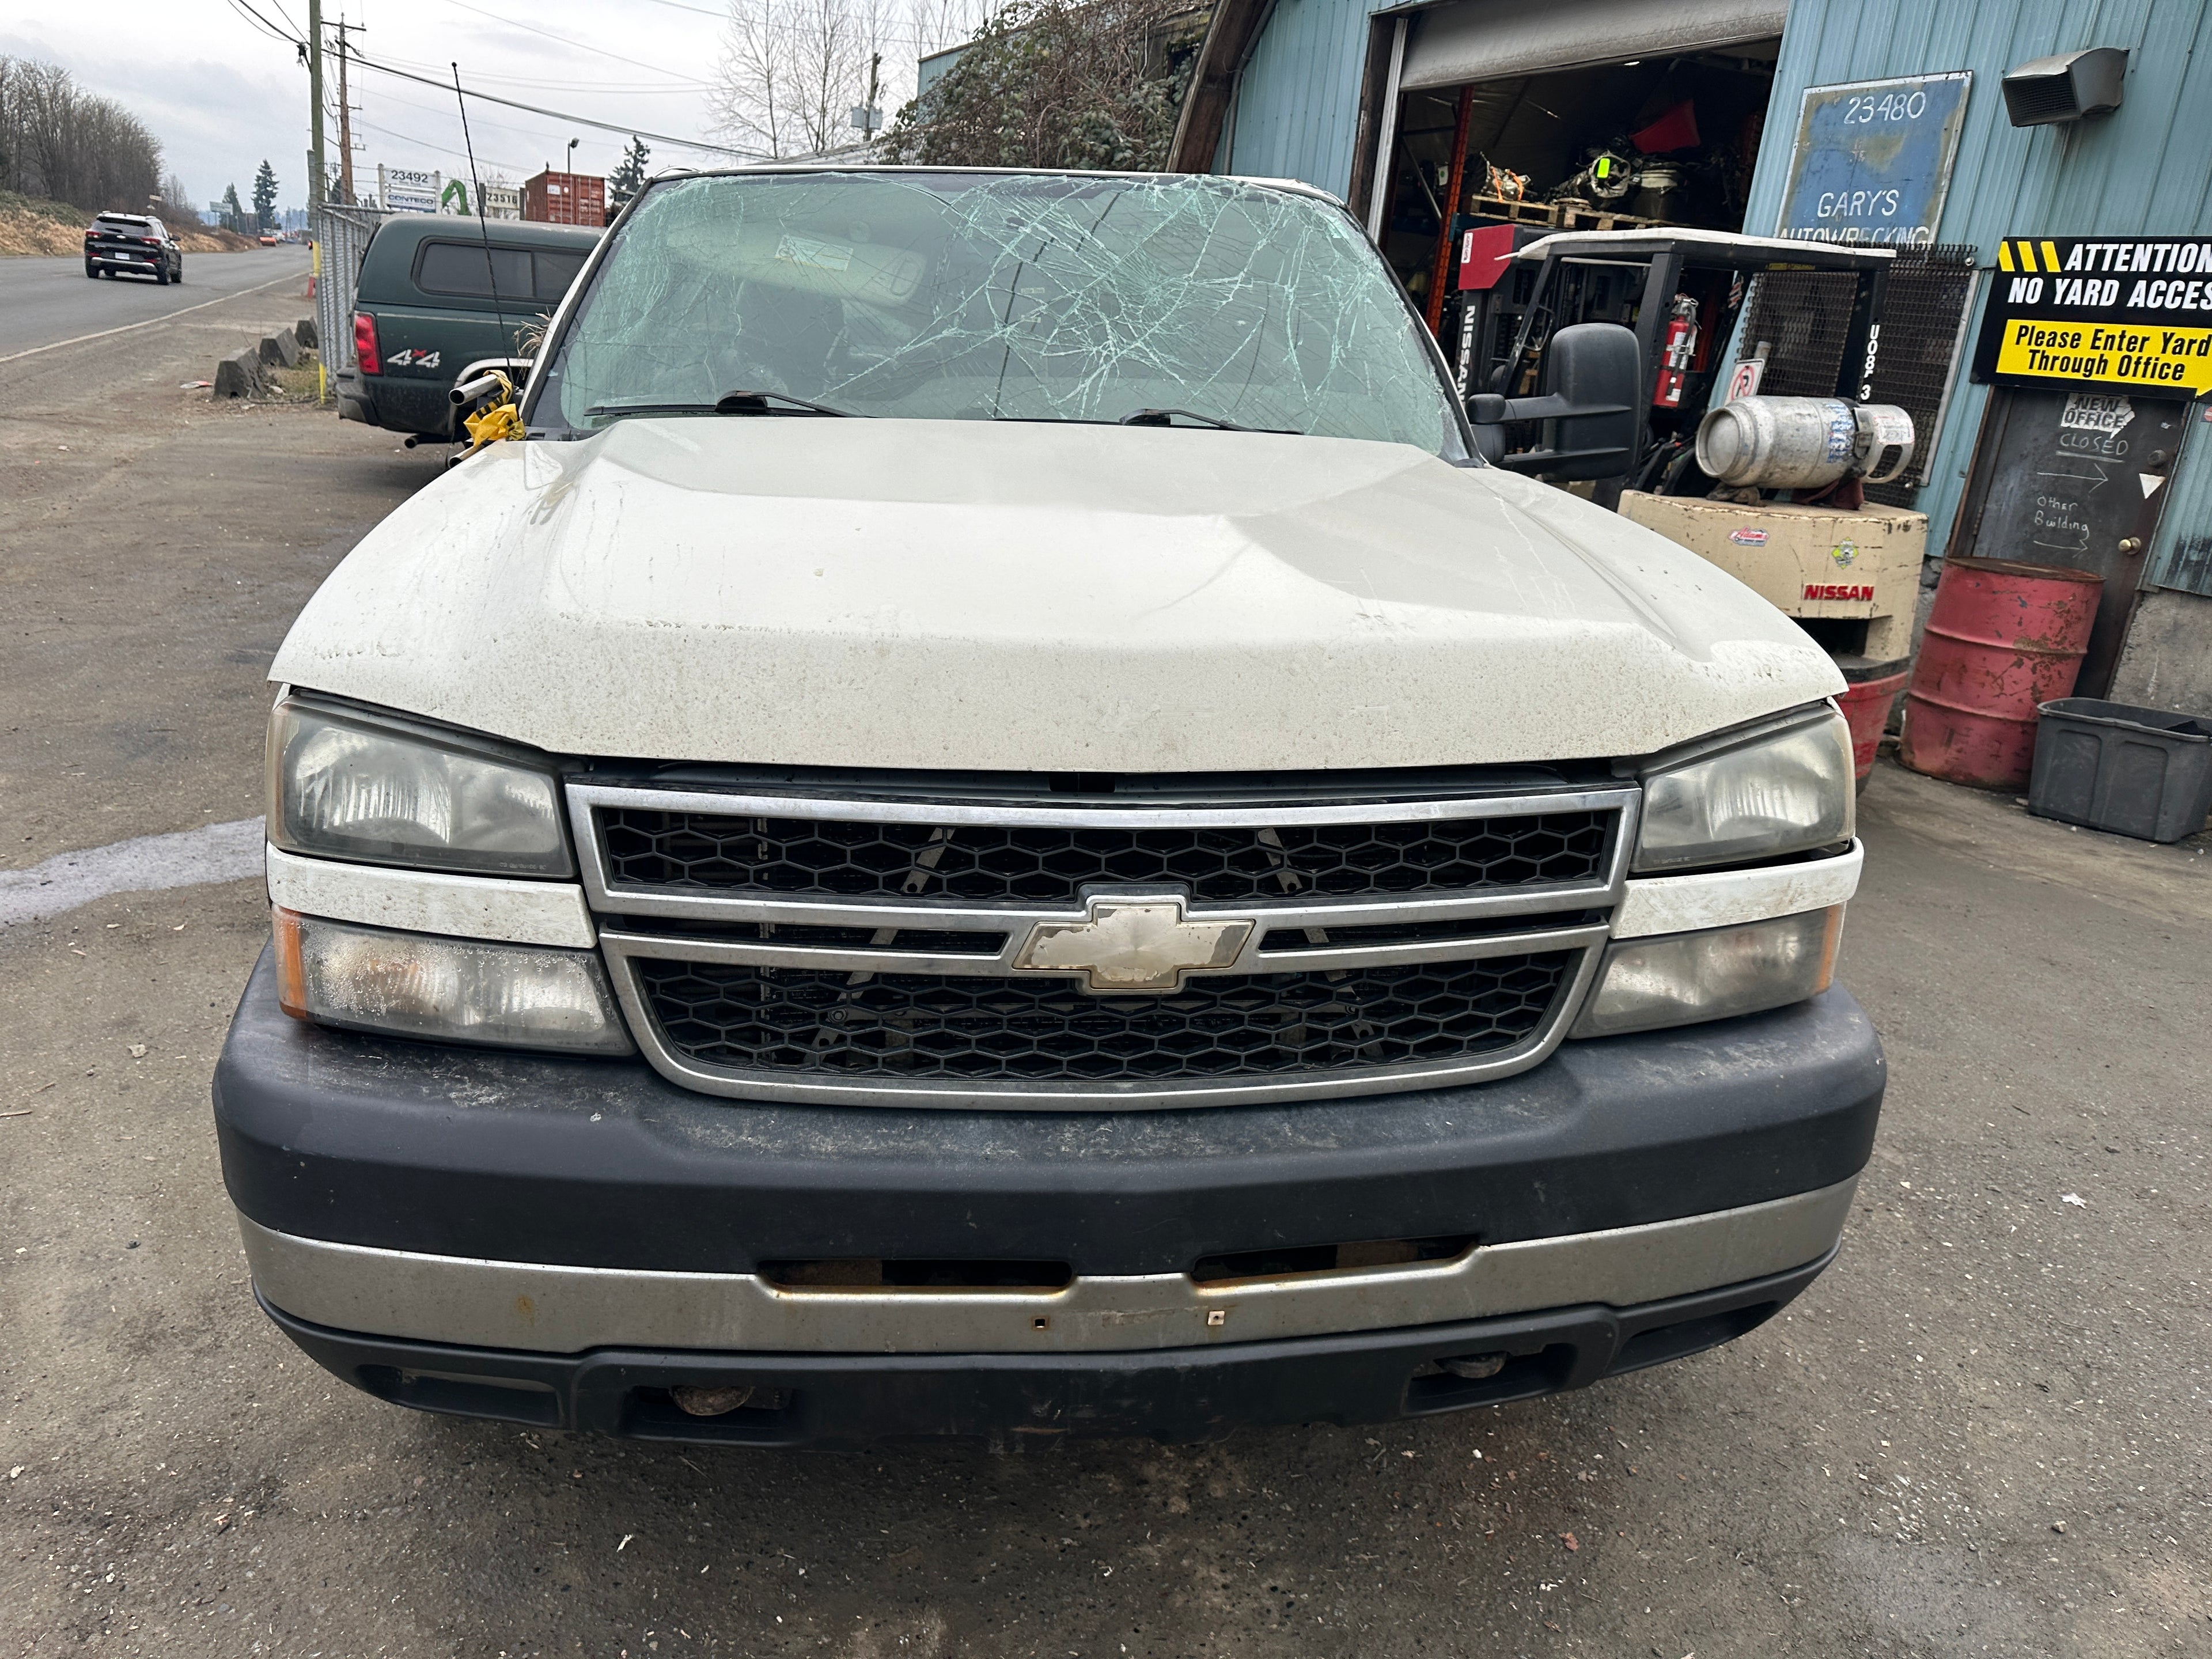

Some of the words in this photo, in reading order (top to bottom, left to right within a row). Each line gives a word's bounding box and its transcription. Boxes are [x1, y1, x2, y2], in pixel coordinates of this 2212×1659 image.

[1843, 91, 1926, 124] 23480
[391, 169, 428, 183] 23492
[388, 195, 433, 204] CONTECO
[1817, 189, 1900, 218] GARY'S
[2063, 243, 2212, 273] ATTENTION
[2008, 277, 2044, 305] NO
[2053, 278, 2120, 306] YARD
[1457, 305, 1476, 402] NISSAN
[2015, 324, 2082, 349] Please
[2090, 328, 2150, 353] Enter
[2161, 331, 2212, 357] Yard
[2028, 349, 2109, 378] Through
[2116, 354, 2186, 381] Office
[2075, 395, 2119, 411] NEW
[2065, 409, 2126, 429] OFFICE
[2060, 433, 2128, 455] CLOSED
[2034, 510, 2090, 540] Building
[1804, 585, 1874, 600] NISSAN
